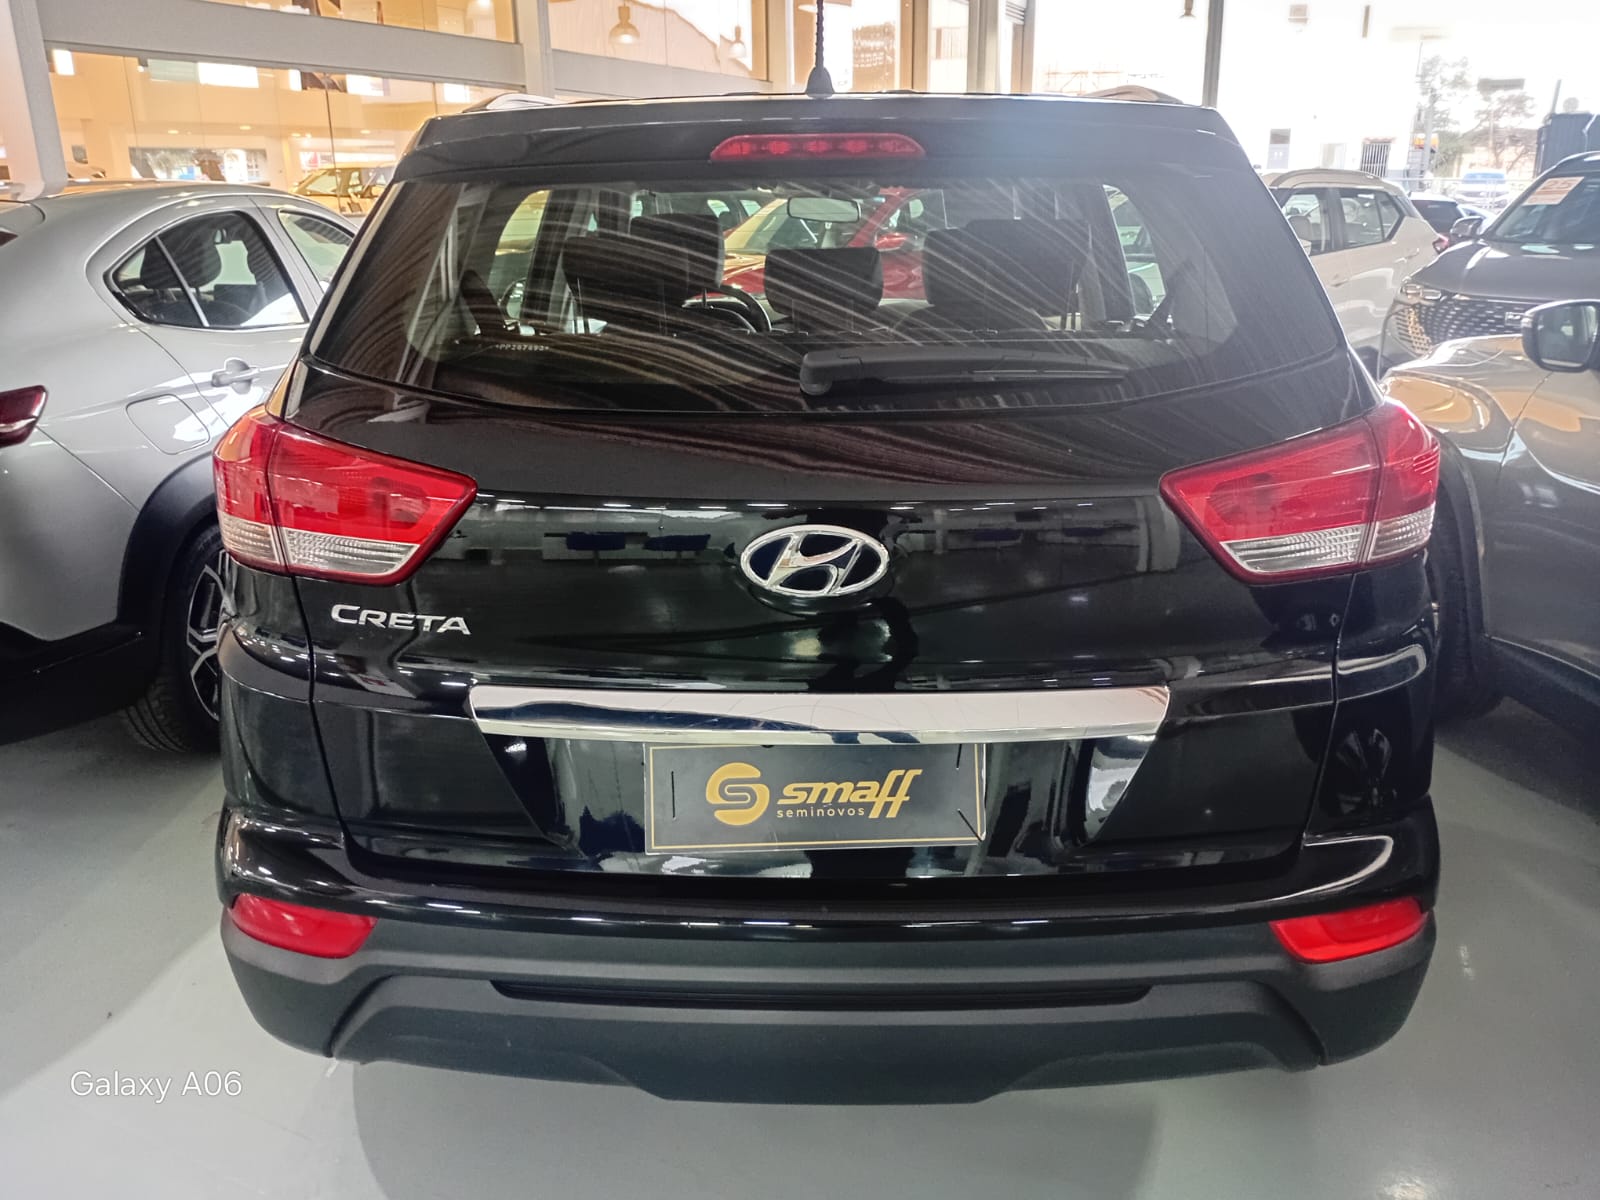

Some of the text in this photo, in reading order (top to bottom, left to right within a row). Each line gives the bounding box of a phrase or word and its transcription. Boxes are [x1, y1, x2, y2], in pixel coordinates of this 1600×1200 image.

[331, 604, 471, 635] CRETA
[777, 769, 923, 819] smaff
[776, 806, 865, 819] seminovos
